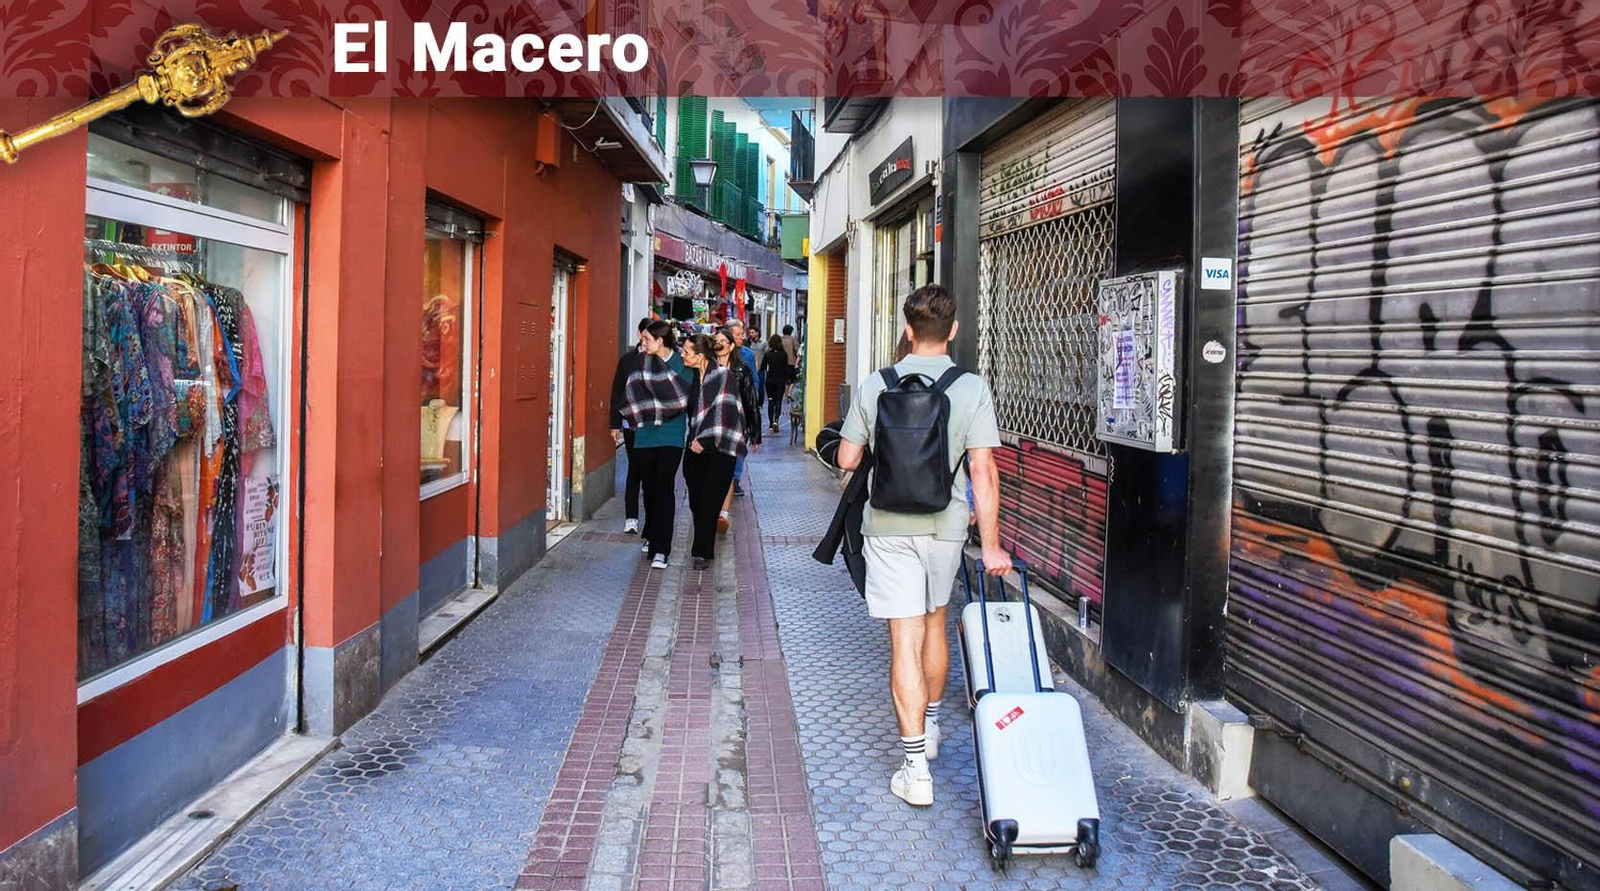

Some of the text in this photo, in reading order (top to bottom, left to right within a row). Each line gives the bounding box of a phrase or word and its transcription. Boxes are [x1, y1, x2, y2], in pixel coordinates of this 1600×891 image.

[151, 243, 192, 251] EXTINTOR
[684, 244, 702, 267] BAZAR
[1205, 269, 1229, 279] VISA
